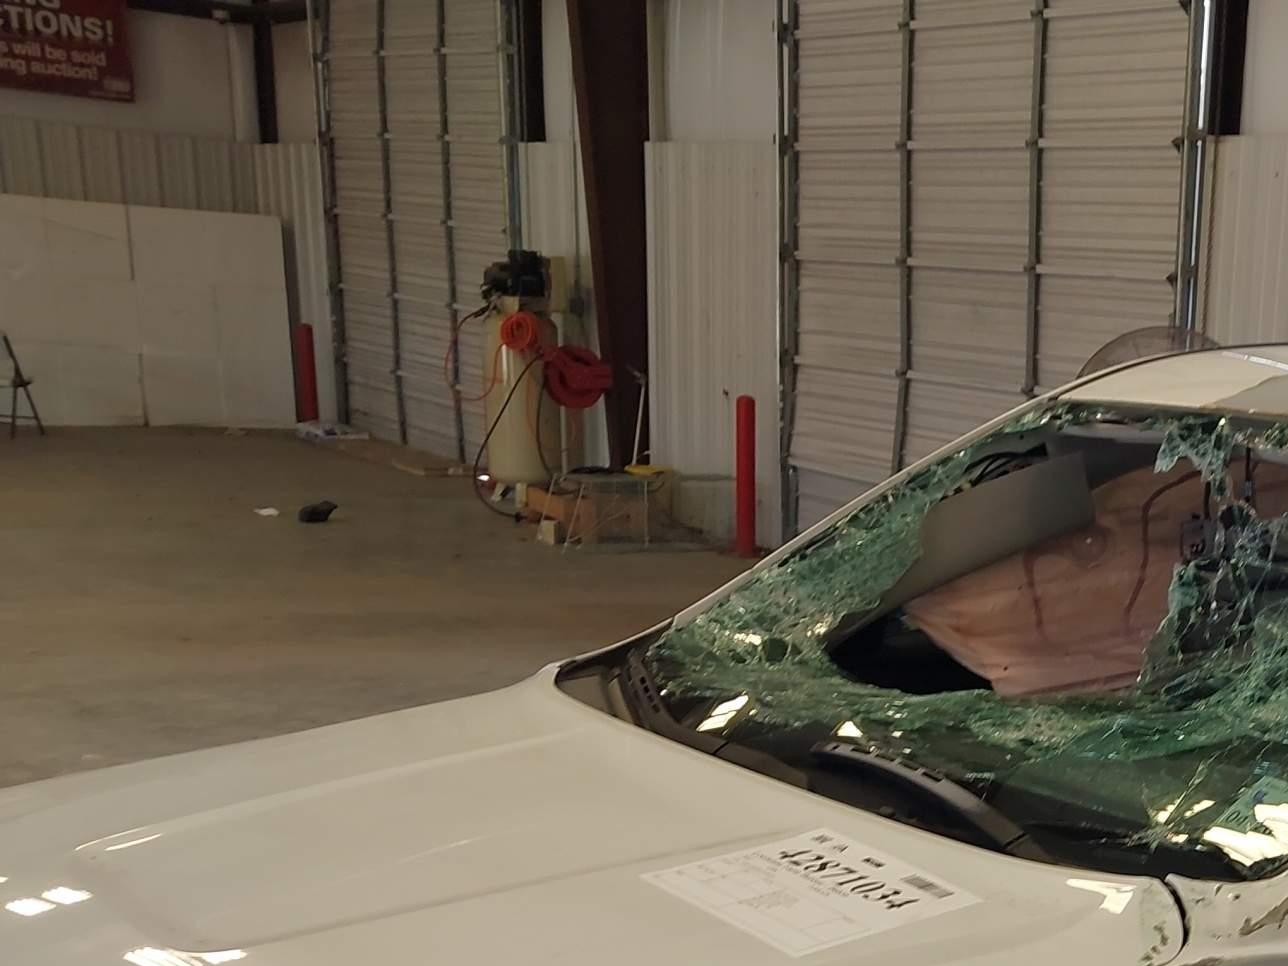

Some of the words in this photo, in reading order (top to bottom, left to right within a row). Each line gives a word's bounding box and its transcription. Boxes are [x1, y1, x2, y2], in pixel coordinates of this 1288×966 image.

[0, 4, 113, 43] TIONS!
[12, 42, 42, 58] will
[45, 44, 67, 62] be
[71, 50, 107, 67] sold
[779, 849, 921, 911] 42871034
